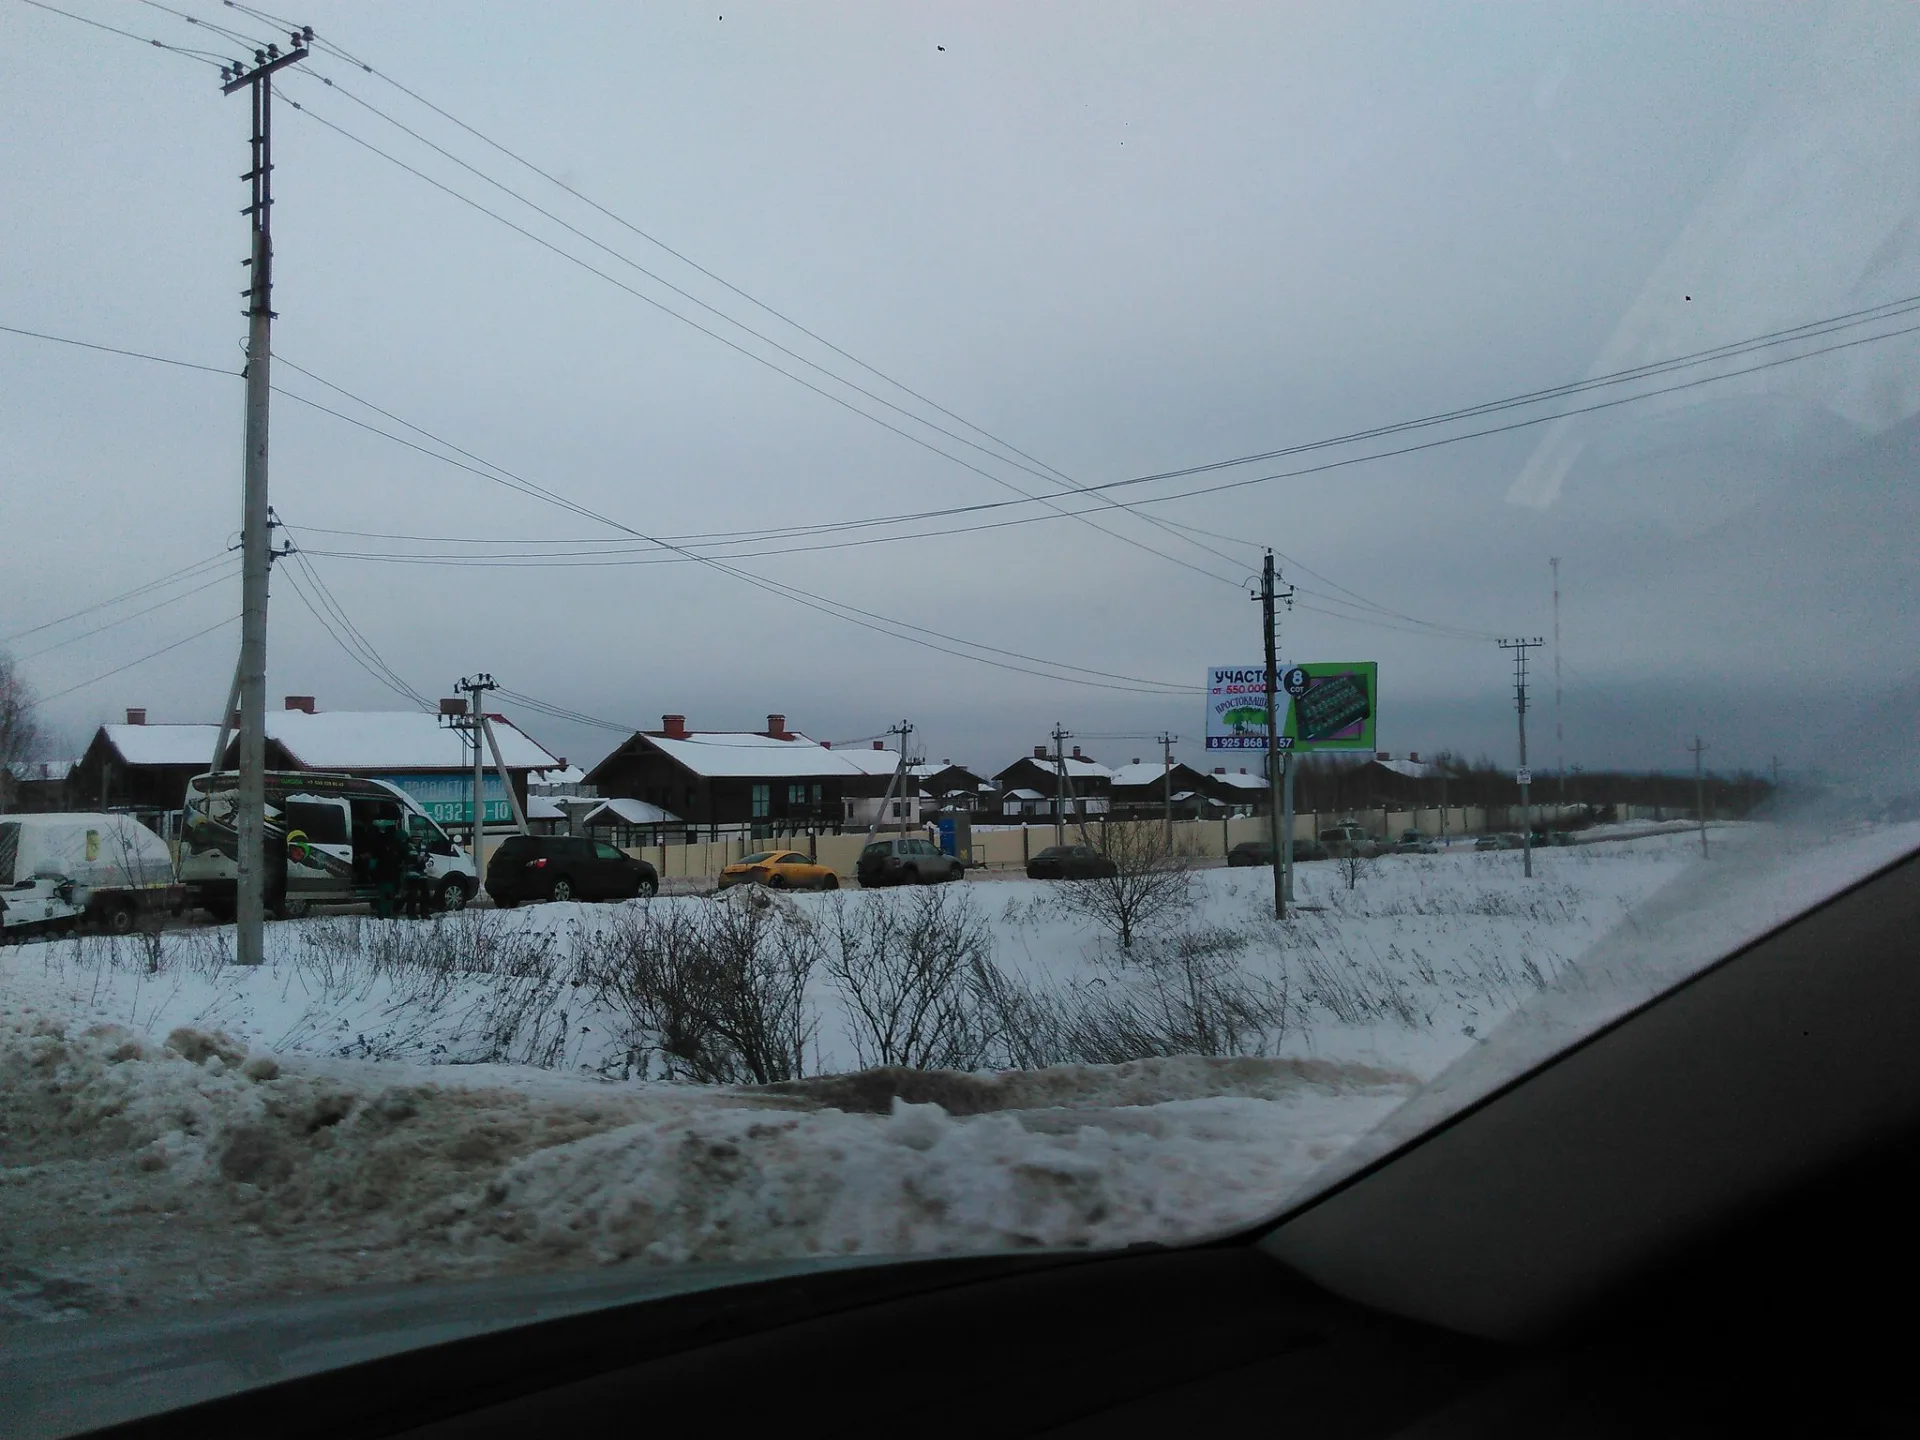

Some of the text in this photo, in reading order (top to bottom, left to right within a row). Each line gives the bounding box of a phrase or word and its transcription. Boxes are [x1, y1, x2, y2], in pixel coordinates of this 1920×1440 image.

[1292, 670, 1303, 685] 8
[1212, 739, 1218, 747] 8
[1221, 739, 1240, 747] 925
[1243, 739, 1263, 747] 868
[1279, 738, 1292, 747] 57
